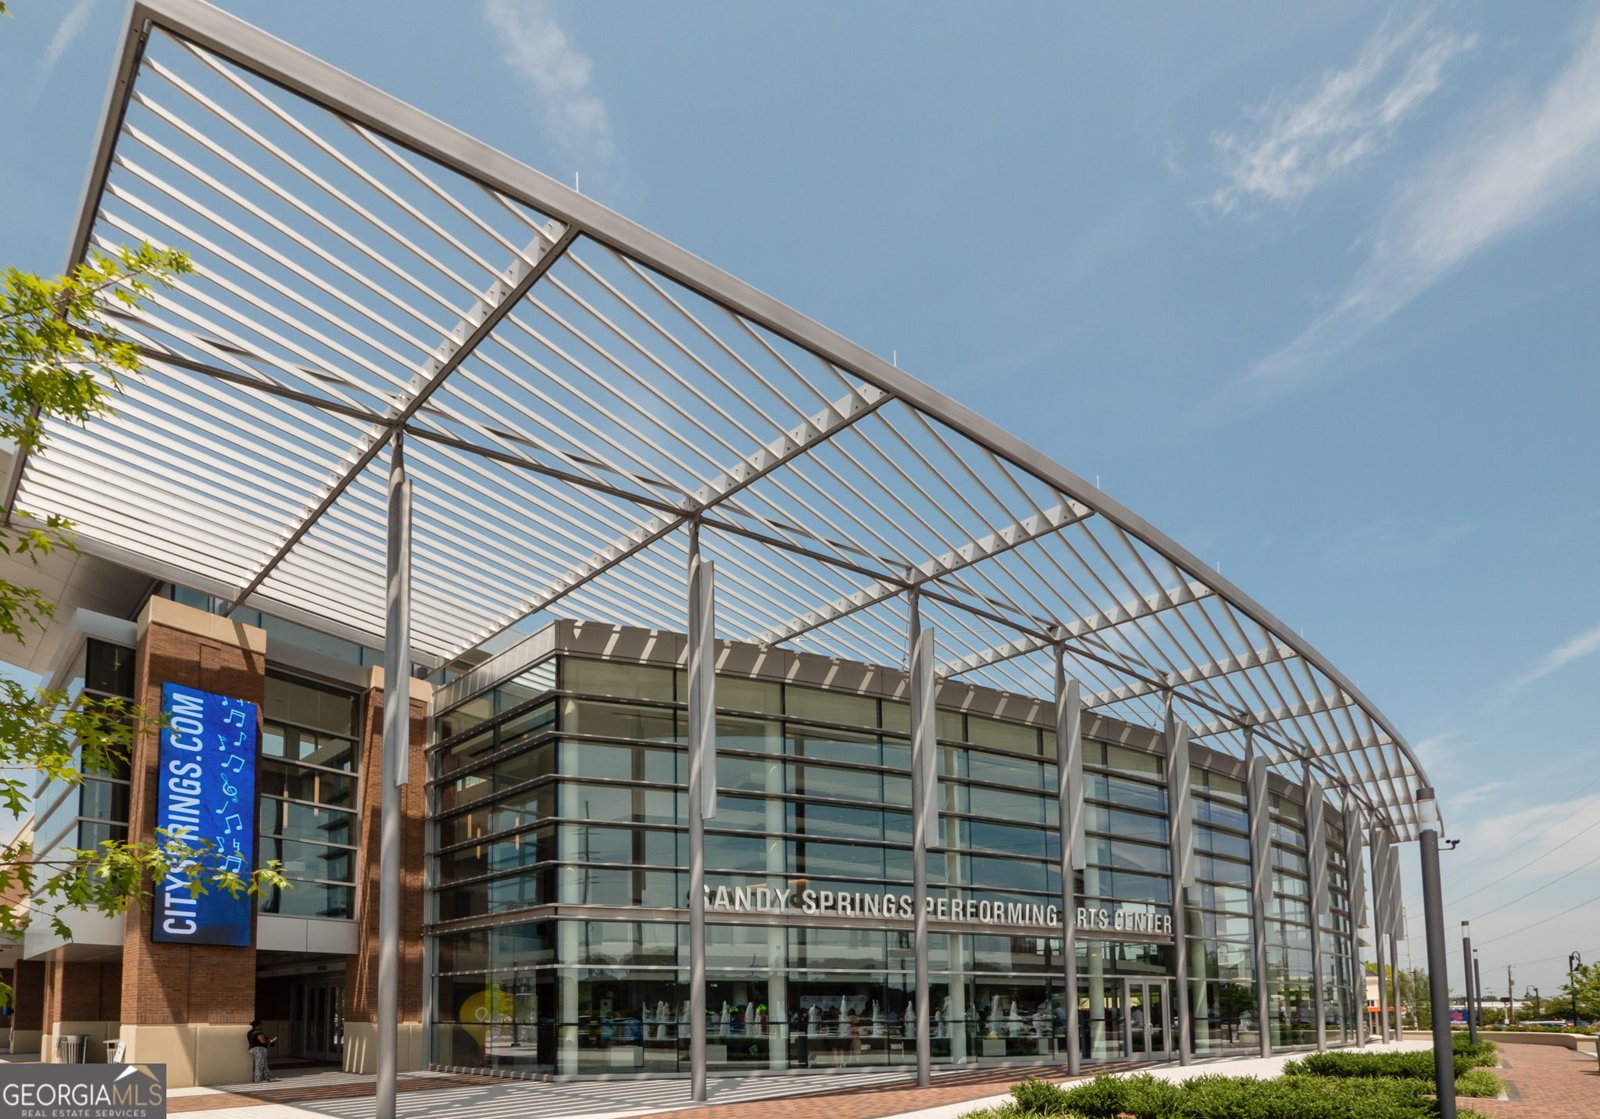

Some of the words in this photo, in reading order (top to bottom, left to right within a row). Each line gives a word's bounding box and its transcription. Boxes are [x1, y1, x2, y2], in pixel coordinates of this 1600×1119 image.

[802, 889, 914, 918] SPRINGS
[926, 897, 1057, 926] PERFORMING
[1074, 907, 1108, 930] RTS
[1114, 908, 1172, 934] CENTER
